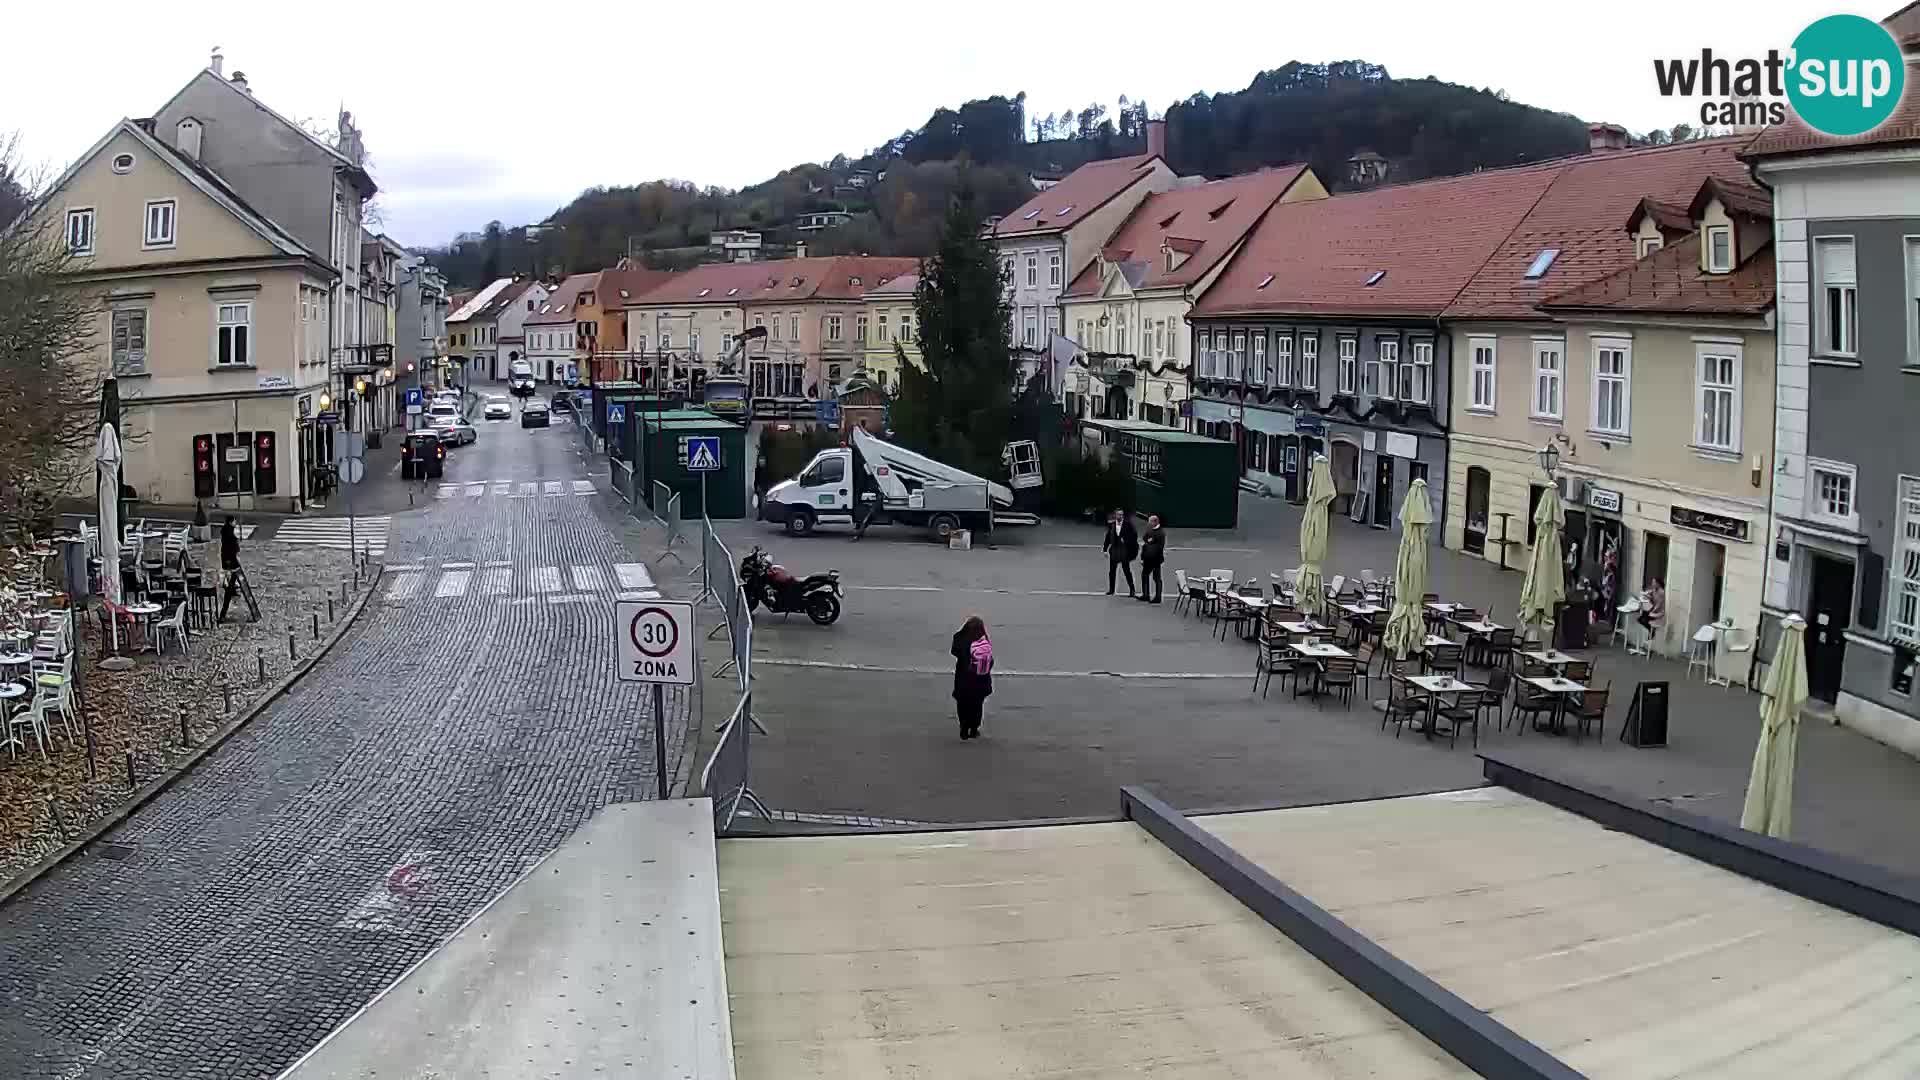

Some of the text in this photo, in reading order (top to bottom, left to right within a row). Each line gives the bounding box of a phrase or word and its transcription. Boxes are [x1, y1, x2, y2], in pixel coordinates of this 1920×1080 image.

[410, 391, 418, 403] P
[643, 623, 667, 645] 30
[633, 660, 678, 677] ZONA
